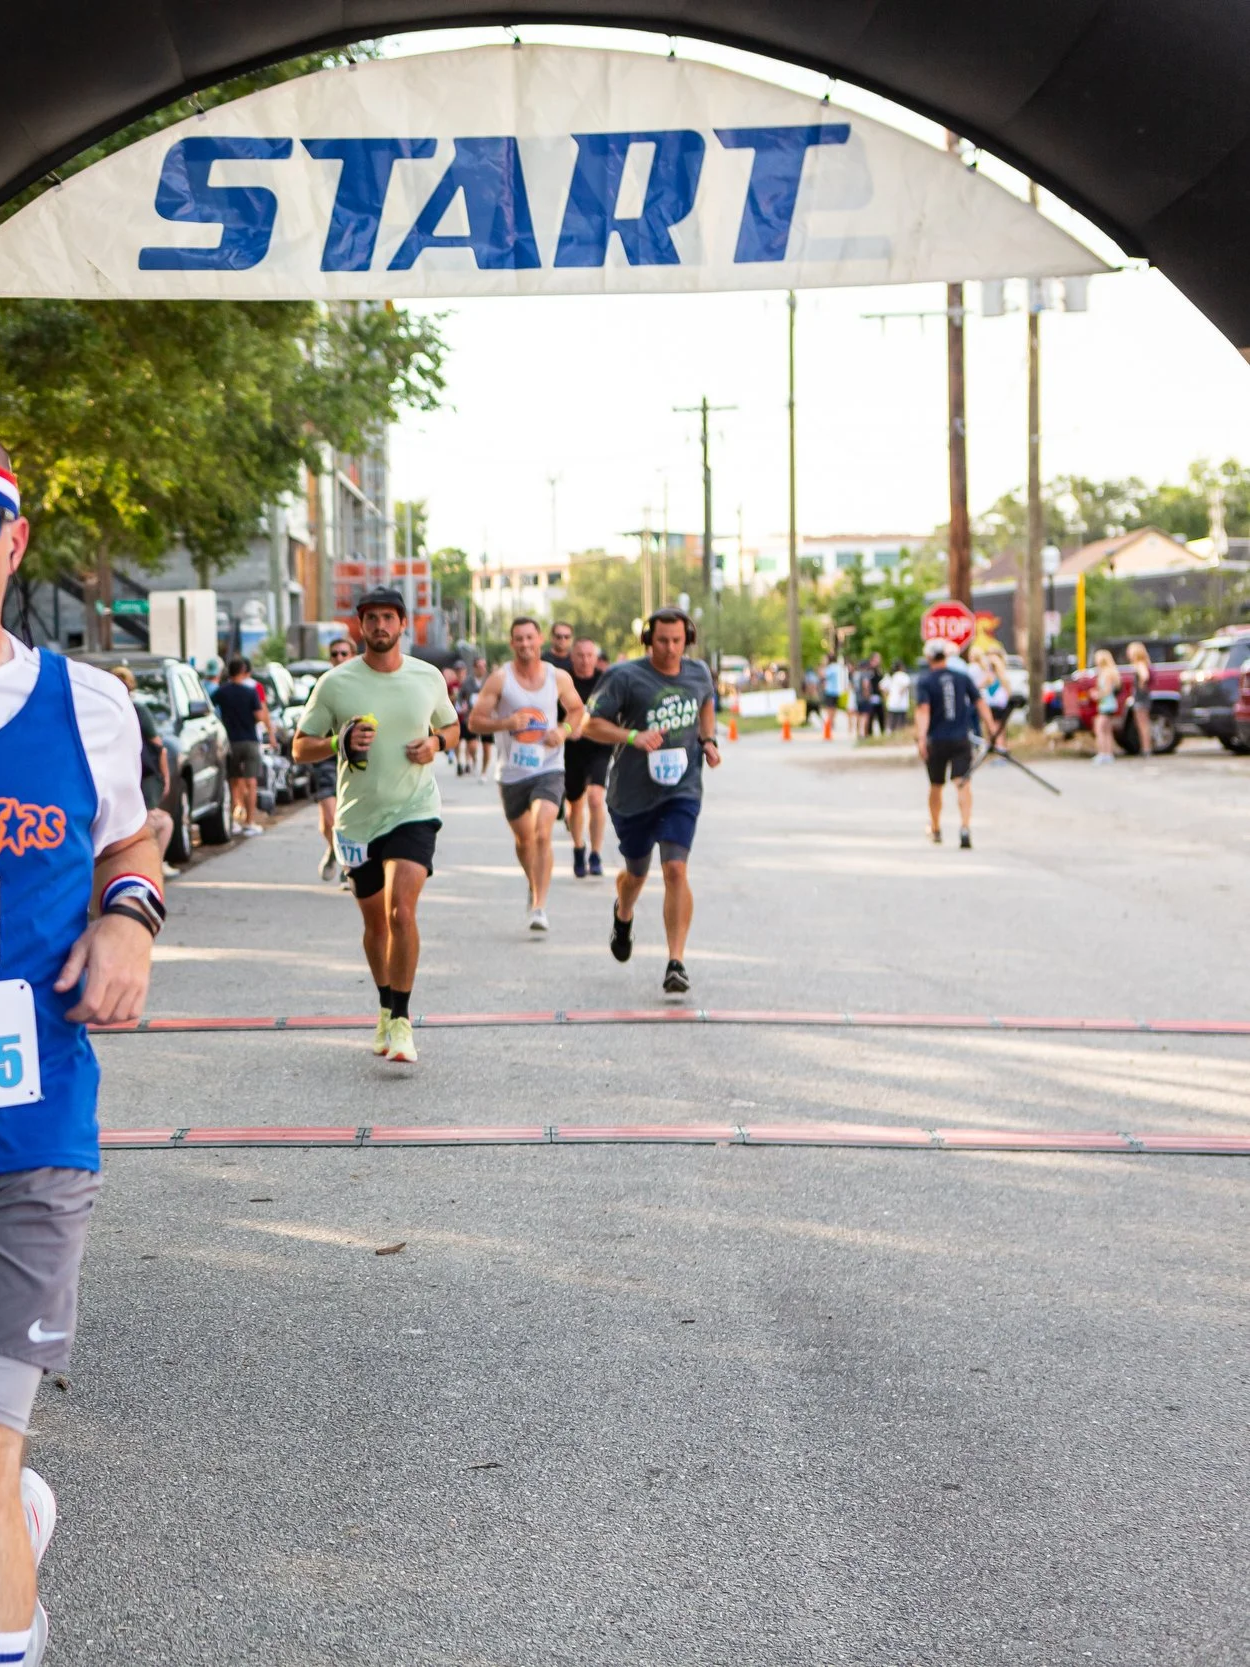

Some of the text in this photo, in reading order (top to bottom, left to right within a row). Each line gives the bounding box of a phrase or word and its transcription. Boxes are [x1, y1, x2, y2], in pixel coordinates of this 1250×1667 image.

[137, 123, 851, 272] START
[927, 615, 970, 637] STOP
[647, 698, 698, 722] SOCIAL
